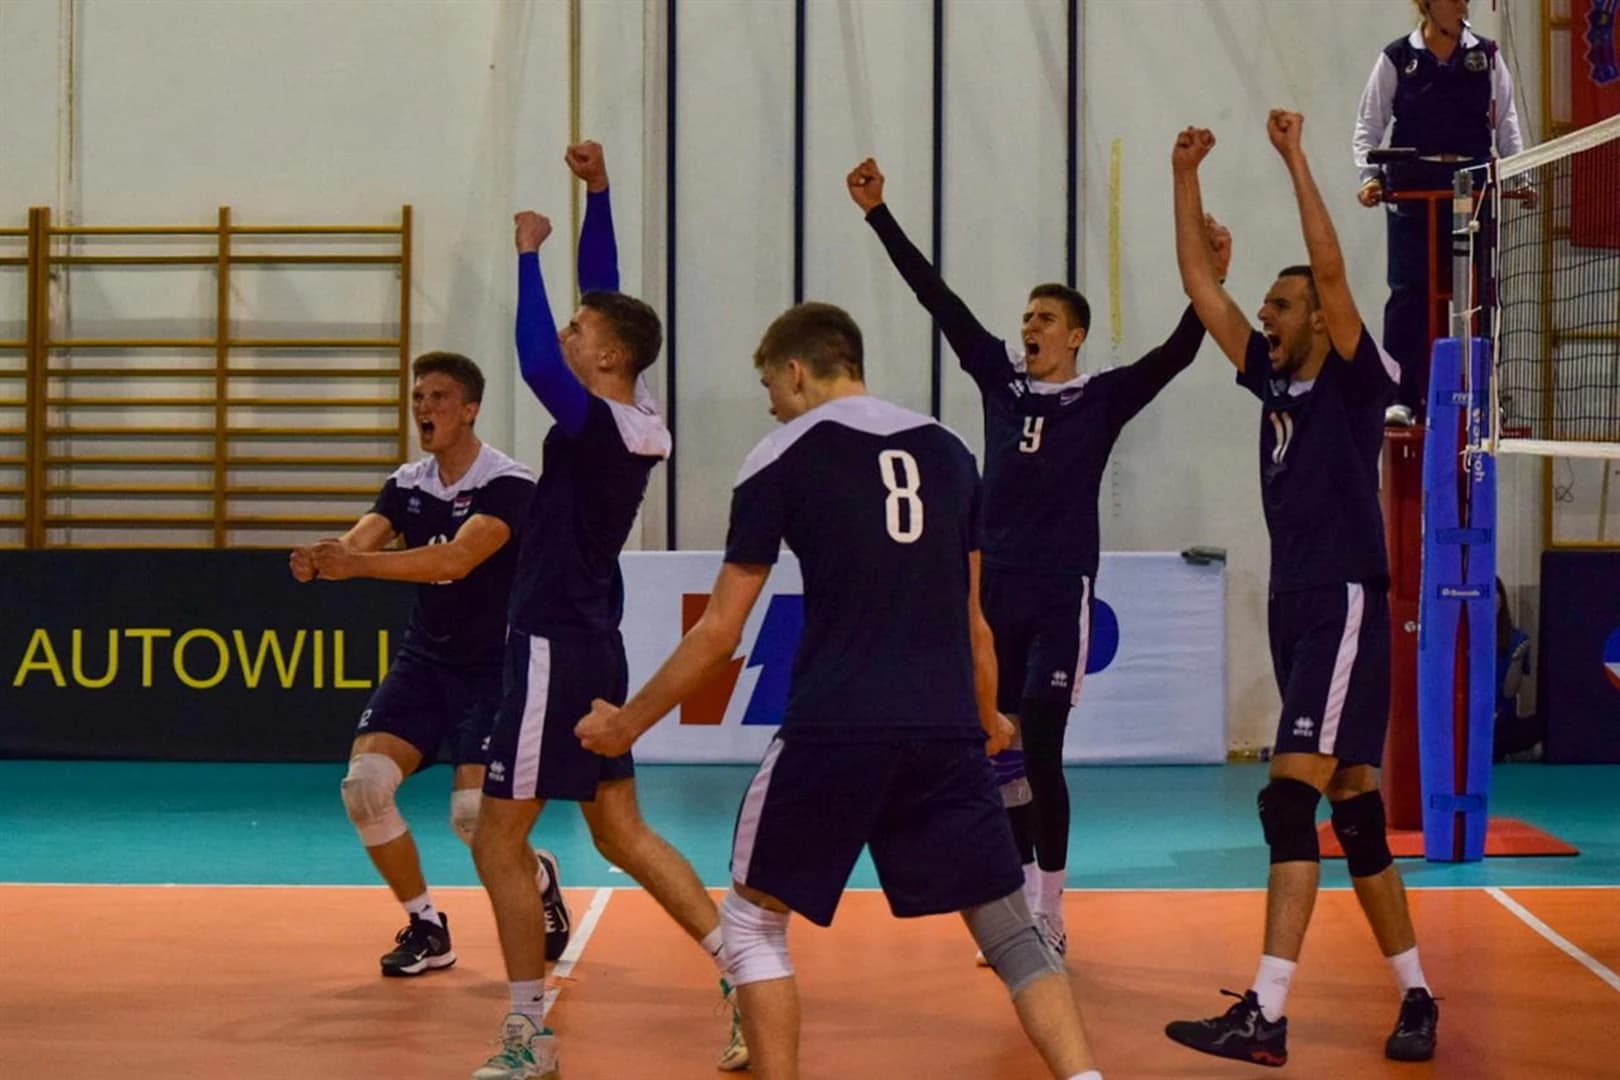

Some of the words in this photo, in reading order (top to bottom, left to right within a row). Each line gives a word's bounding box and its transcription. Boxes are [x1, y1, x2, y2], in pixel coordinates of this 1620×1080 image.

[1019, 416, 1045, 454] 9
[1270, 411, 1294, 464] 11
[878, 449, 924, 543] 8
